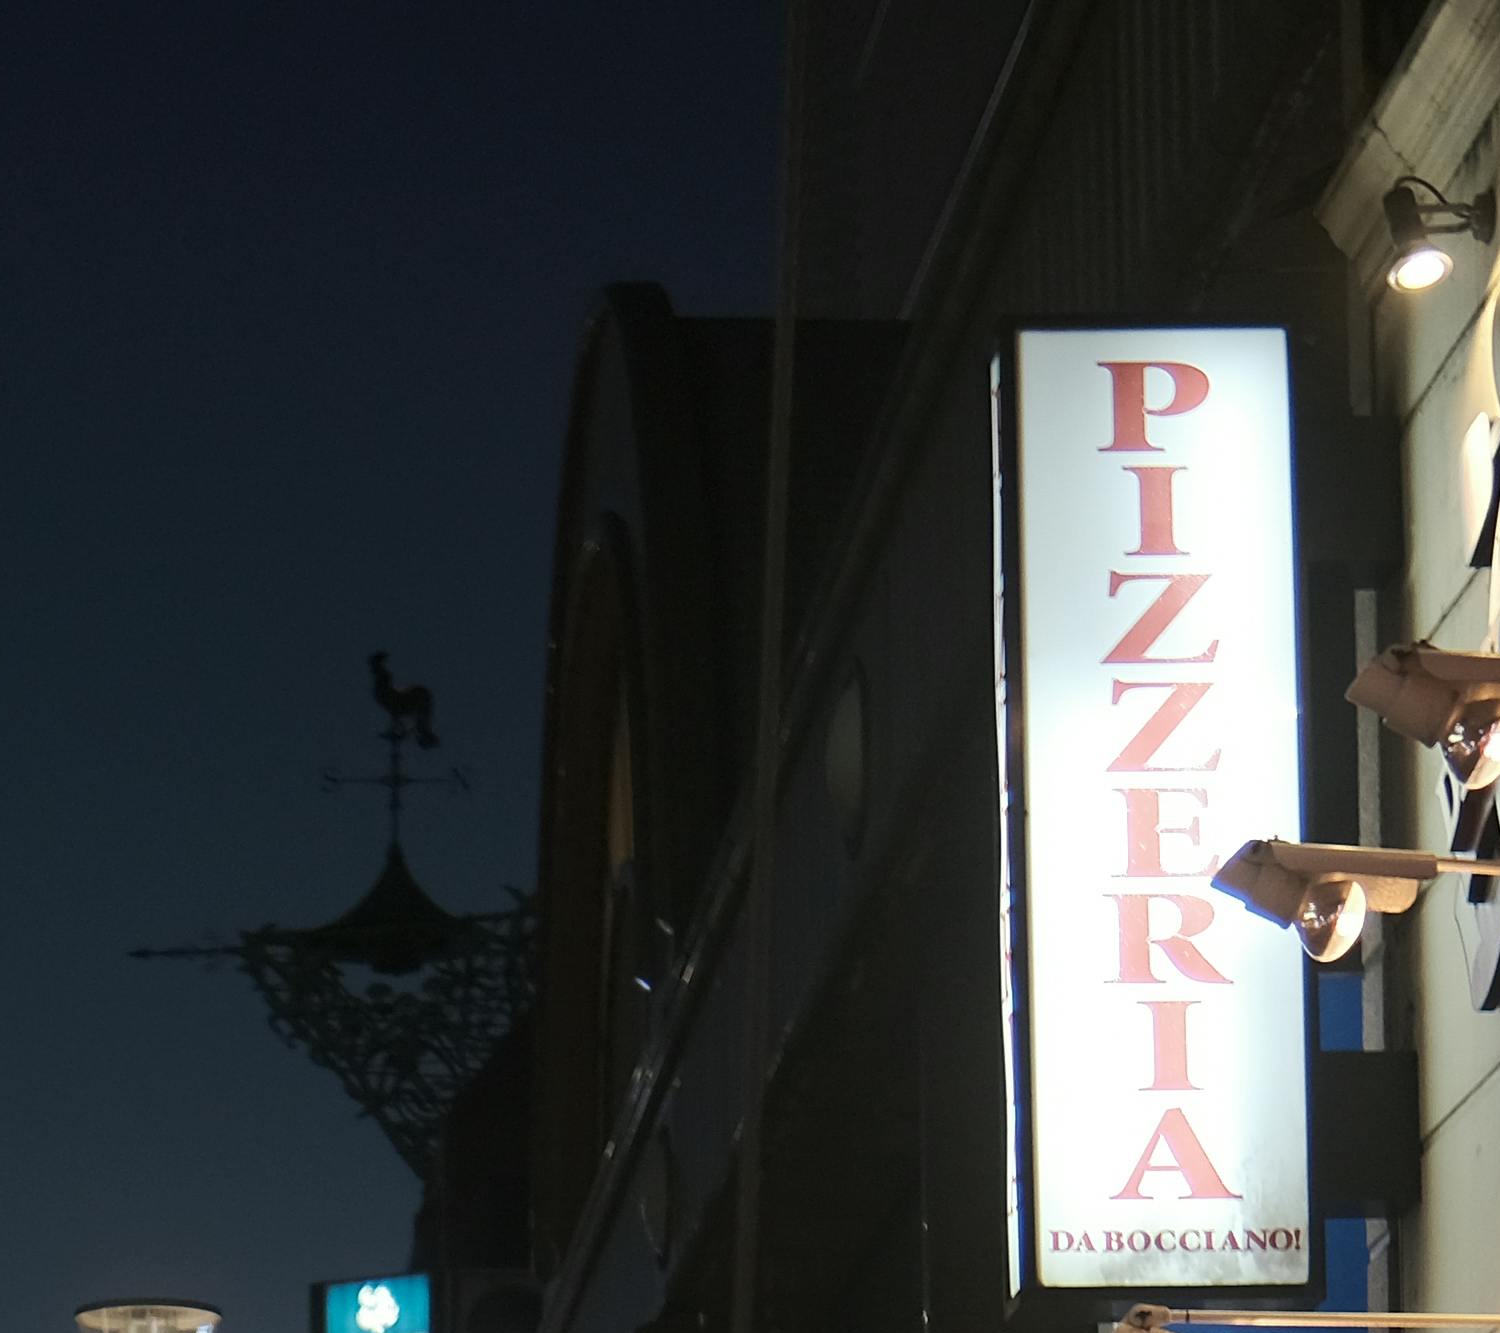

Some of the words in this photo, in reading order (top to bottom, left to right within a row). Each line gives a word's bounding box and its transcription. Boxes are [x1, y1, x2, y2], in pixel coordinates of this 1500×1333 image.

[1096, 360, 1244, 1201] PIZZERIA
[1050, 1229, 1096, 1252] DA
[1103, 1229, 1302, 1252] BOCCIANO!
